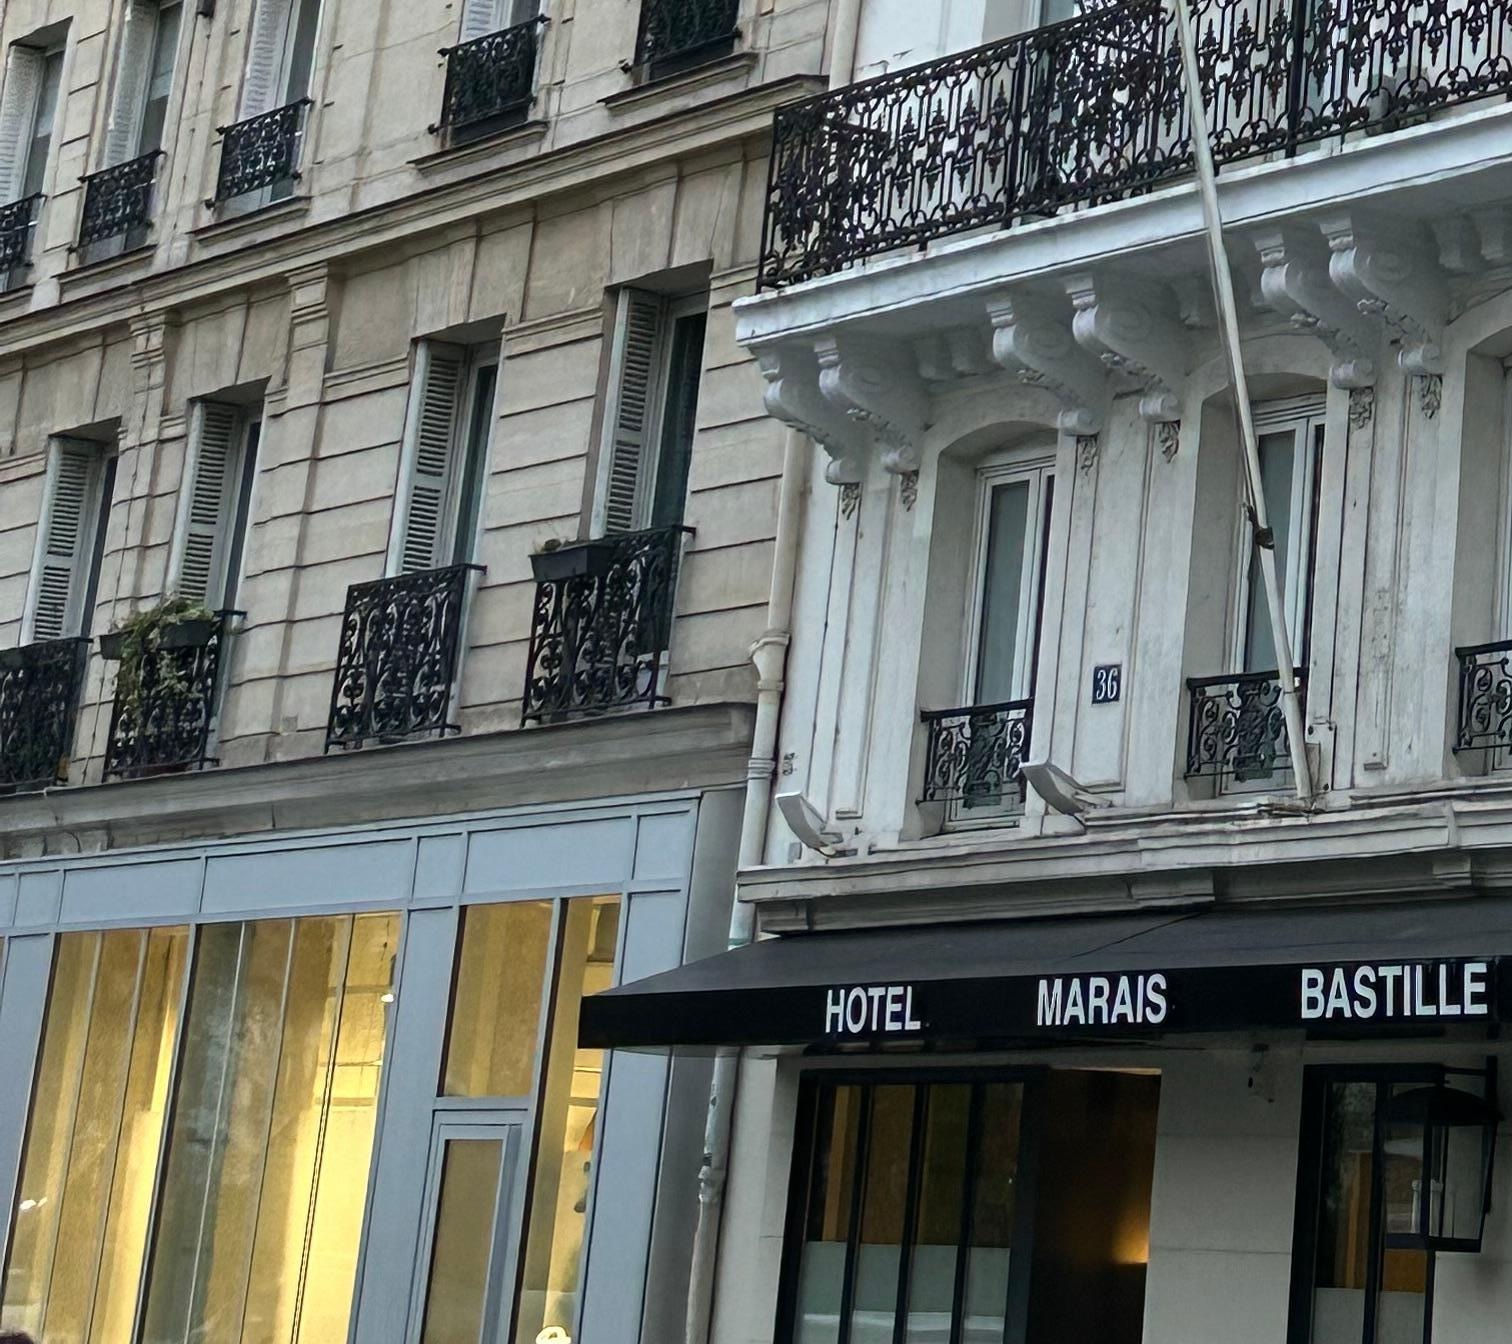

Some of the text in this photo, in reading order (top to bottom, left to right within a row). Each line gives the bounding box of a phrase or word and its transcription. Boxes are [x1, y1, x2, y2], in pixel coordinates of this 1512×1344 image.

[1096, 667, 1118, 700] 36
[825, 962, 1488, 1033] HOTEL MARAIS BASTILLE
